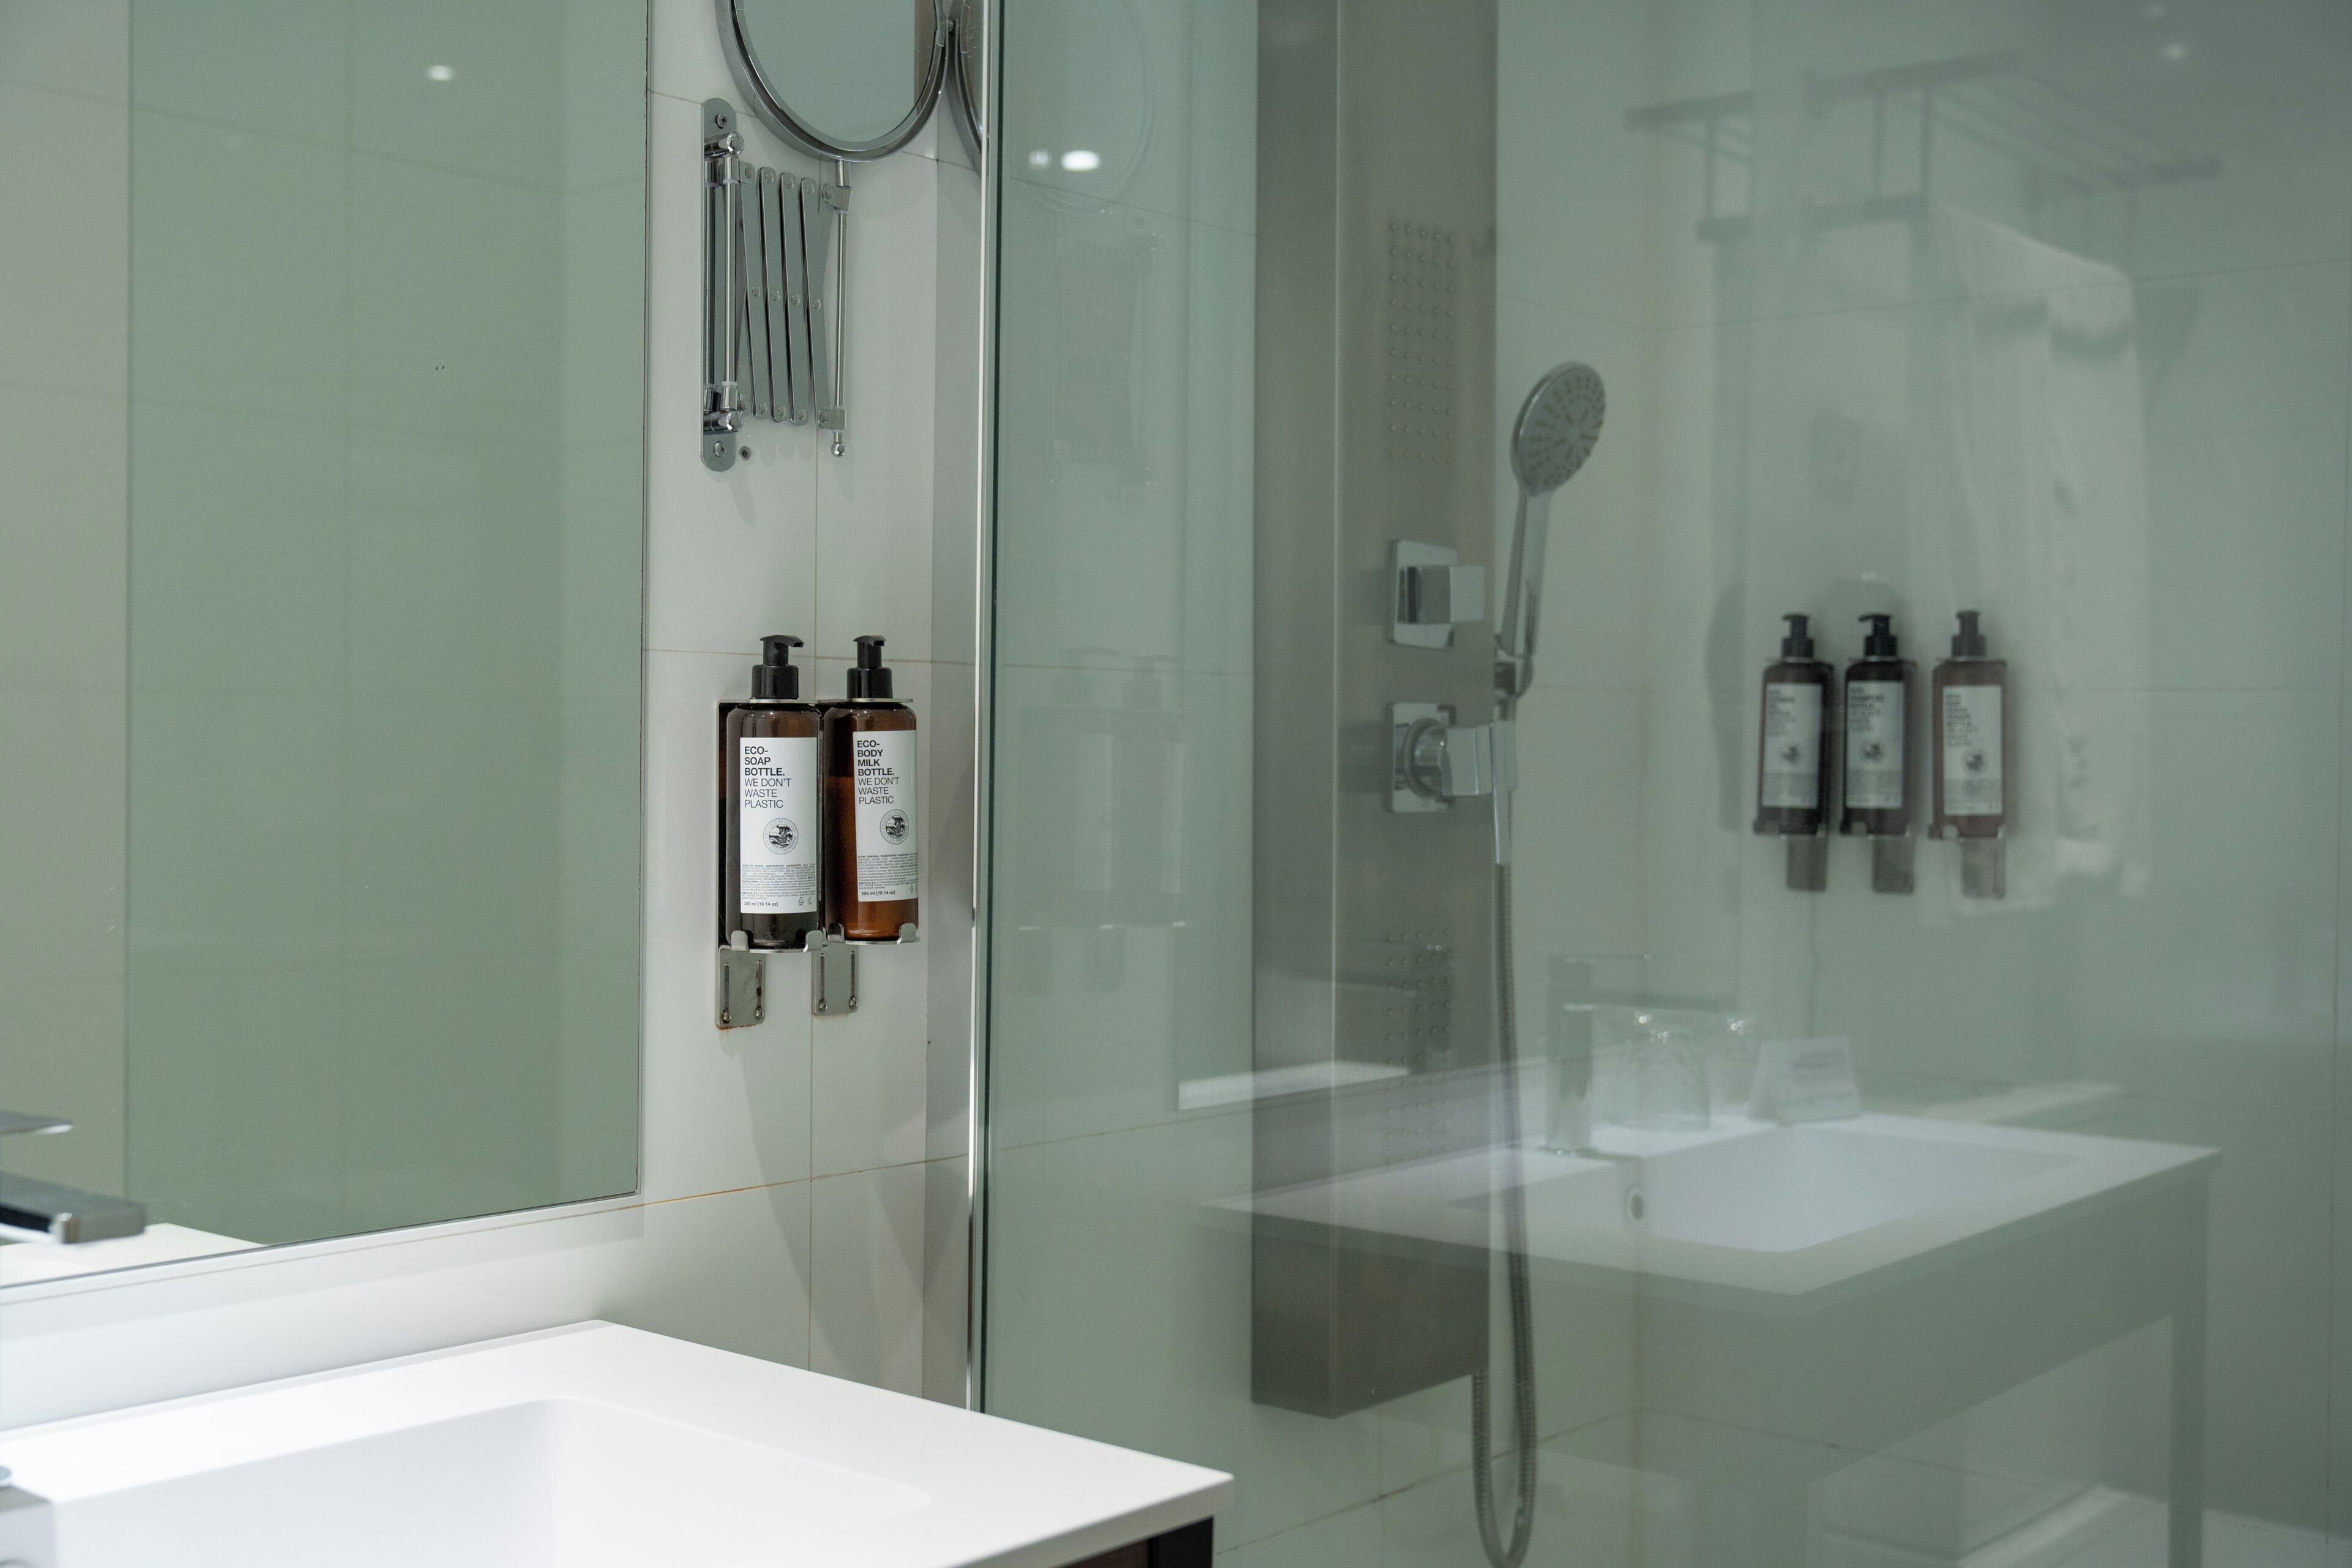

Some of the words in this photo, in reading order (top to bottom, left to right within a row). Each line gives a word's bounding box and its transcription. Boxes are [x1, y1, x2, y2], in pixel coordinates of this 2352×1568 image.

[857, 739, 880, 748] ECO-
[744, 746, 768, 755] ECO-
[744, 756, 771, 766] SOAP
[858, 758, 880, 767] MILK
[744, 767, 785, 776] BOTTLE.
[744, 778, 759, 786] WE
[761, 778, 791, 786] DON'T
[858, 777, 872, 786] WE
[874, 777, 900, 785] DON'T
[744, 789, 777, 797] WASTE
[858, 786, 889, 795] WASTE
[744, 799, 783, 809] PLASTIC
[859, 796, 894, 804] PLASTIC
